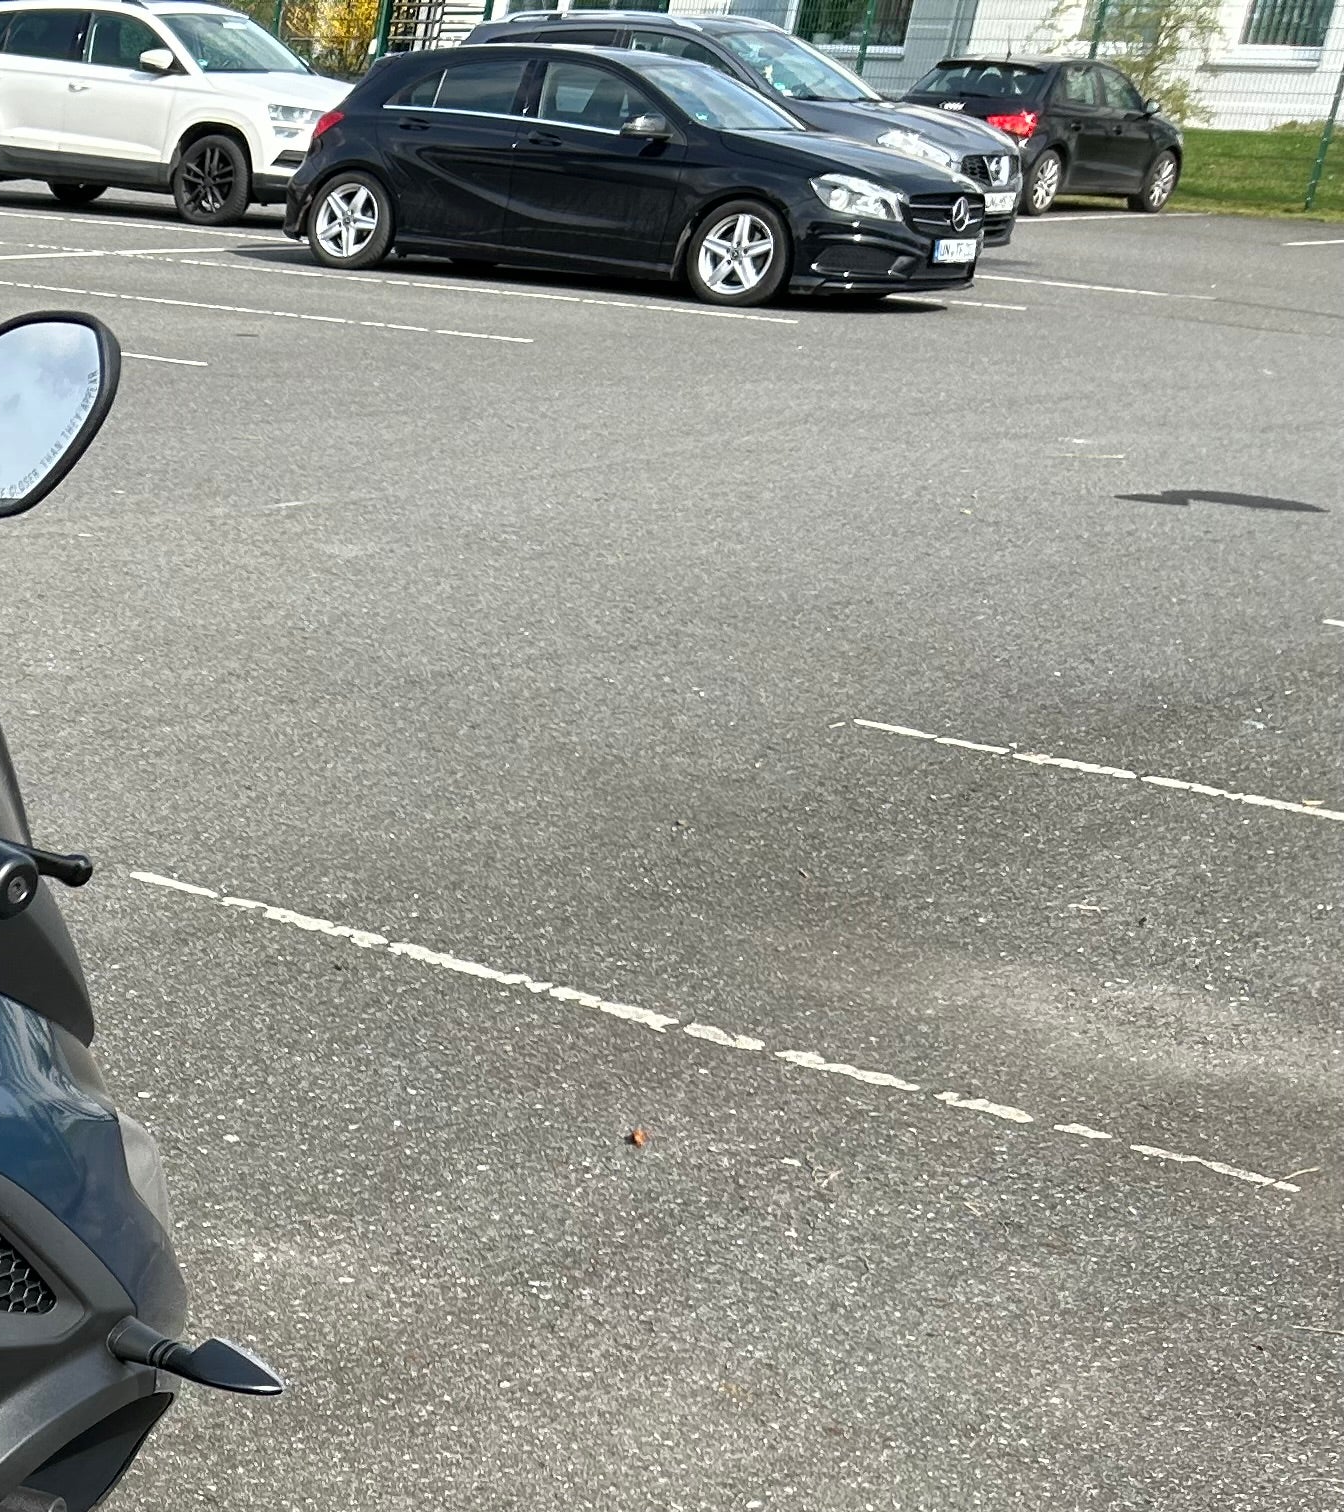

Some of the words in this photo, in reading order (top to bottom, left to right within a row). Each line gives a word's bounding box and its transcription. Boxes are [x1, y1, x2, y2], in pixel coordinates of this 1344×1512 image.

[9, 468, 40, 498] CLOSER
[39, 440, 63, 469] THAN
[60, 413, 83, 441] THEY
